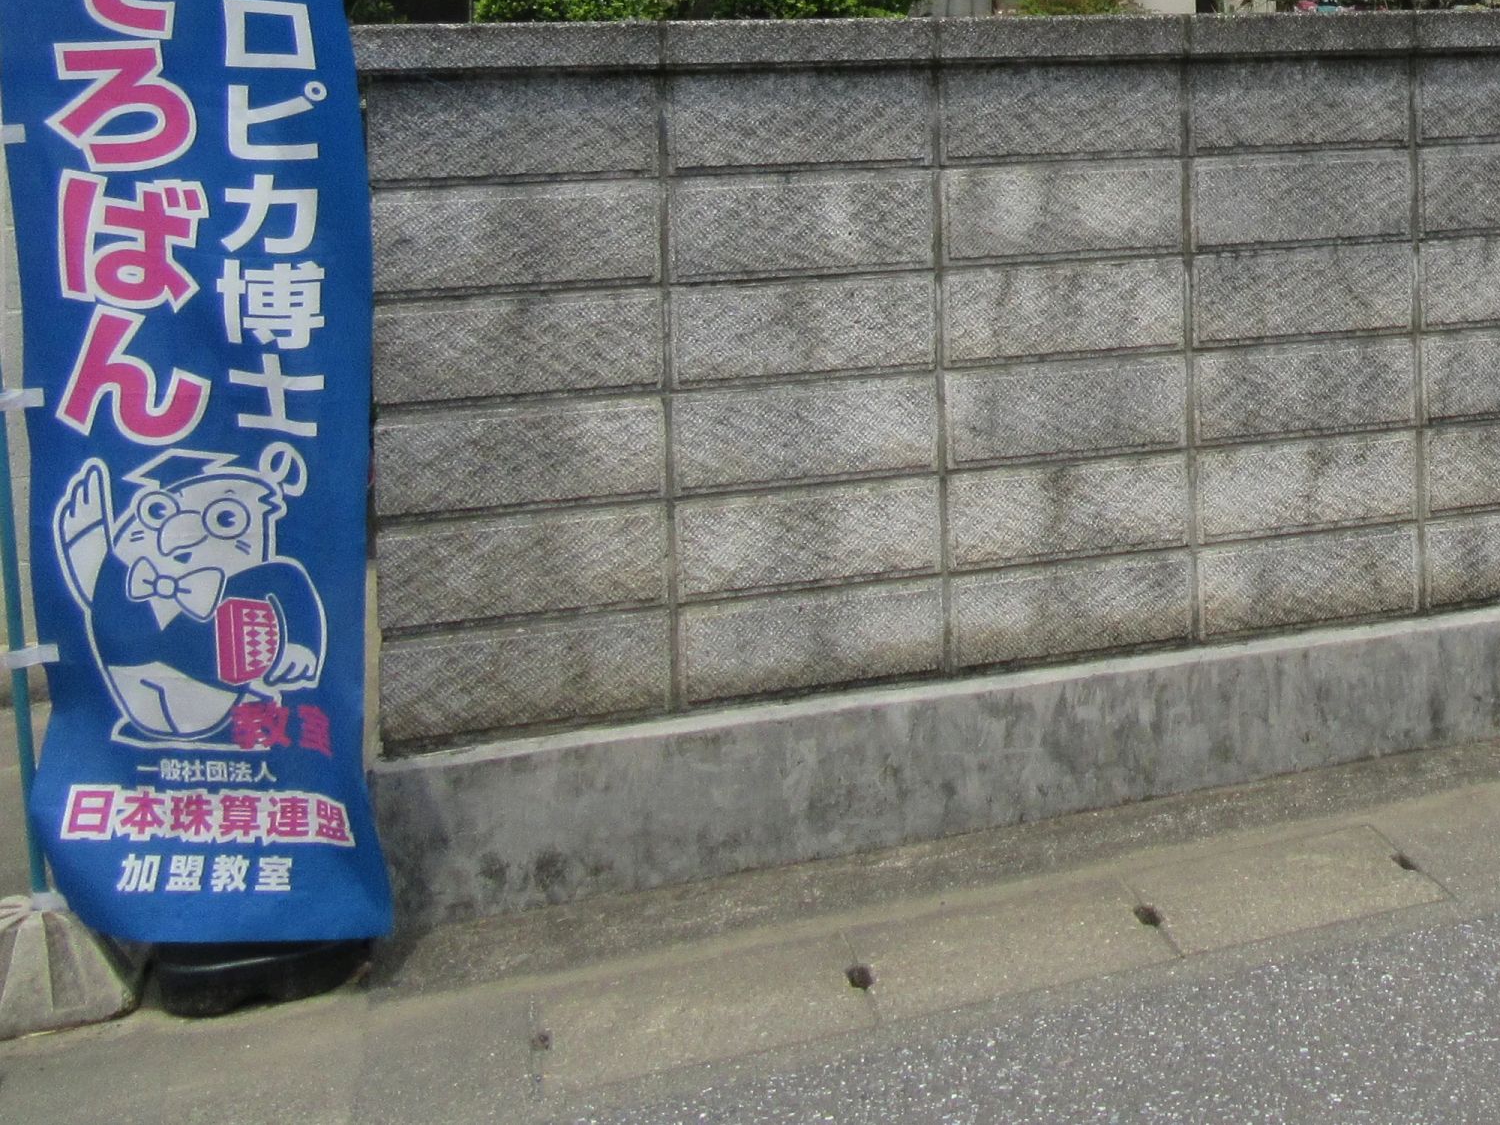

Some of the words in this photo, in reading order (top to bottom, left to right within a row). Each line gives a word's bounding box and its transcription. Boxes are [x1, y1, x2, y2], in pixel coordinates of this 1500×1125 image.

[136, 758, 278, 783] 一般社団法人
[60, 784, 356, 847] 日本珠算連盟
[116, 854, 293, 893] 加盟教室
